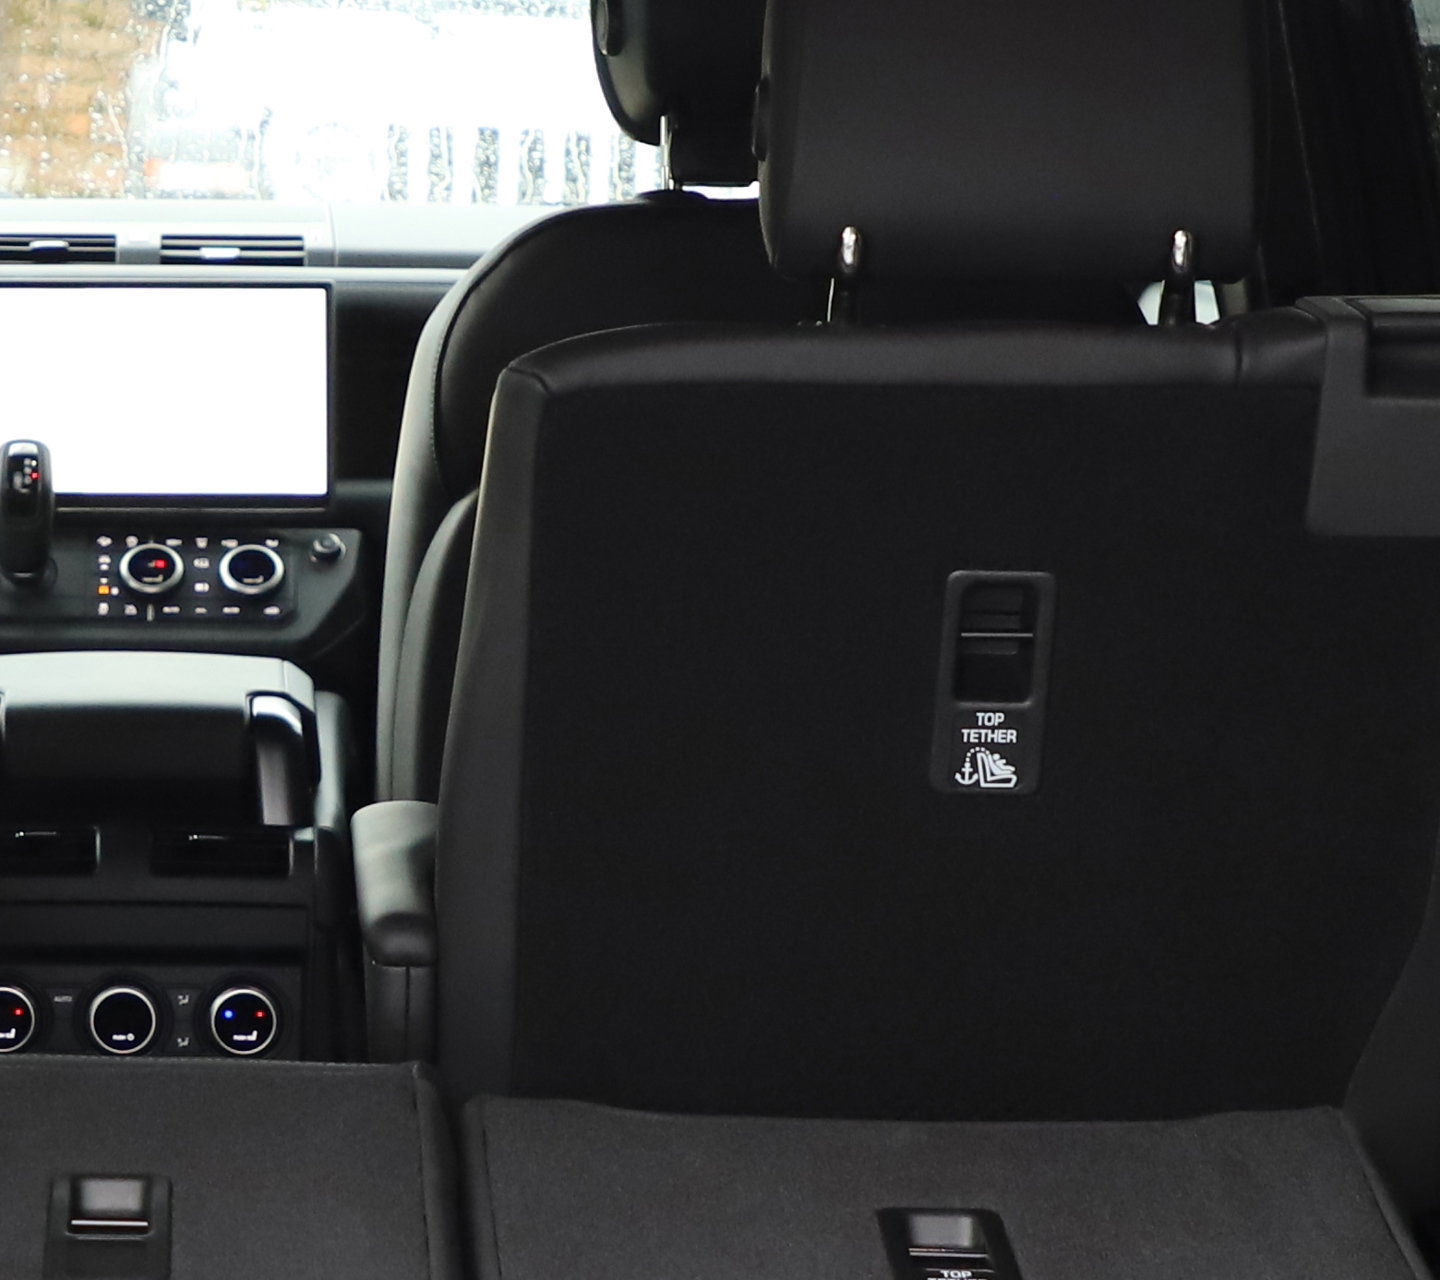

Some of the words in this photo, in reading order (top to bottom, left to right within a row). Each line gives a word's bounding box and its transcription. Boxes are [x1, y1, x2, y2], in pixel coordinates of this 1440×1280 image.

[976, 712, 1005, 727] TOP
[961, 729, 1017, 744] TETHER
[941, 1270, 973, 1279] TOP
